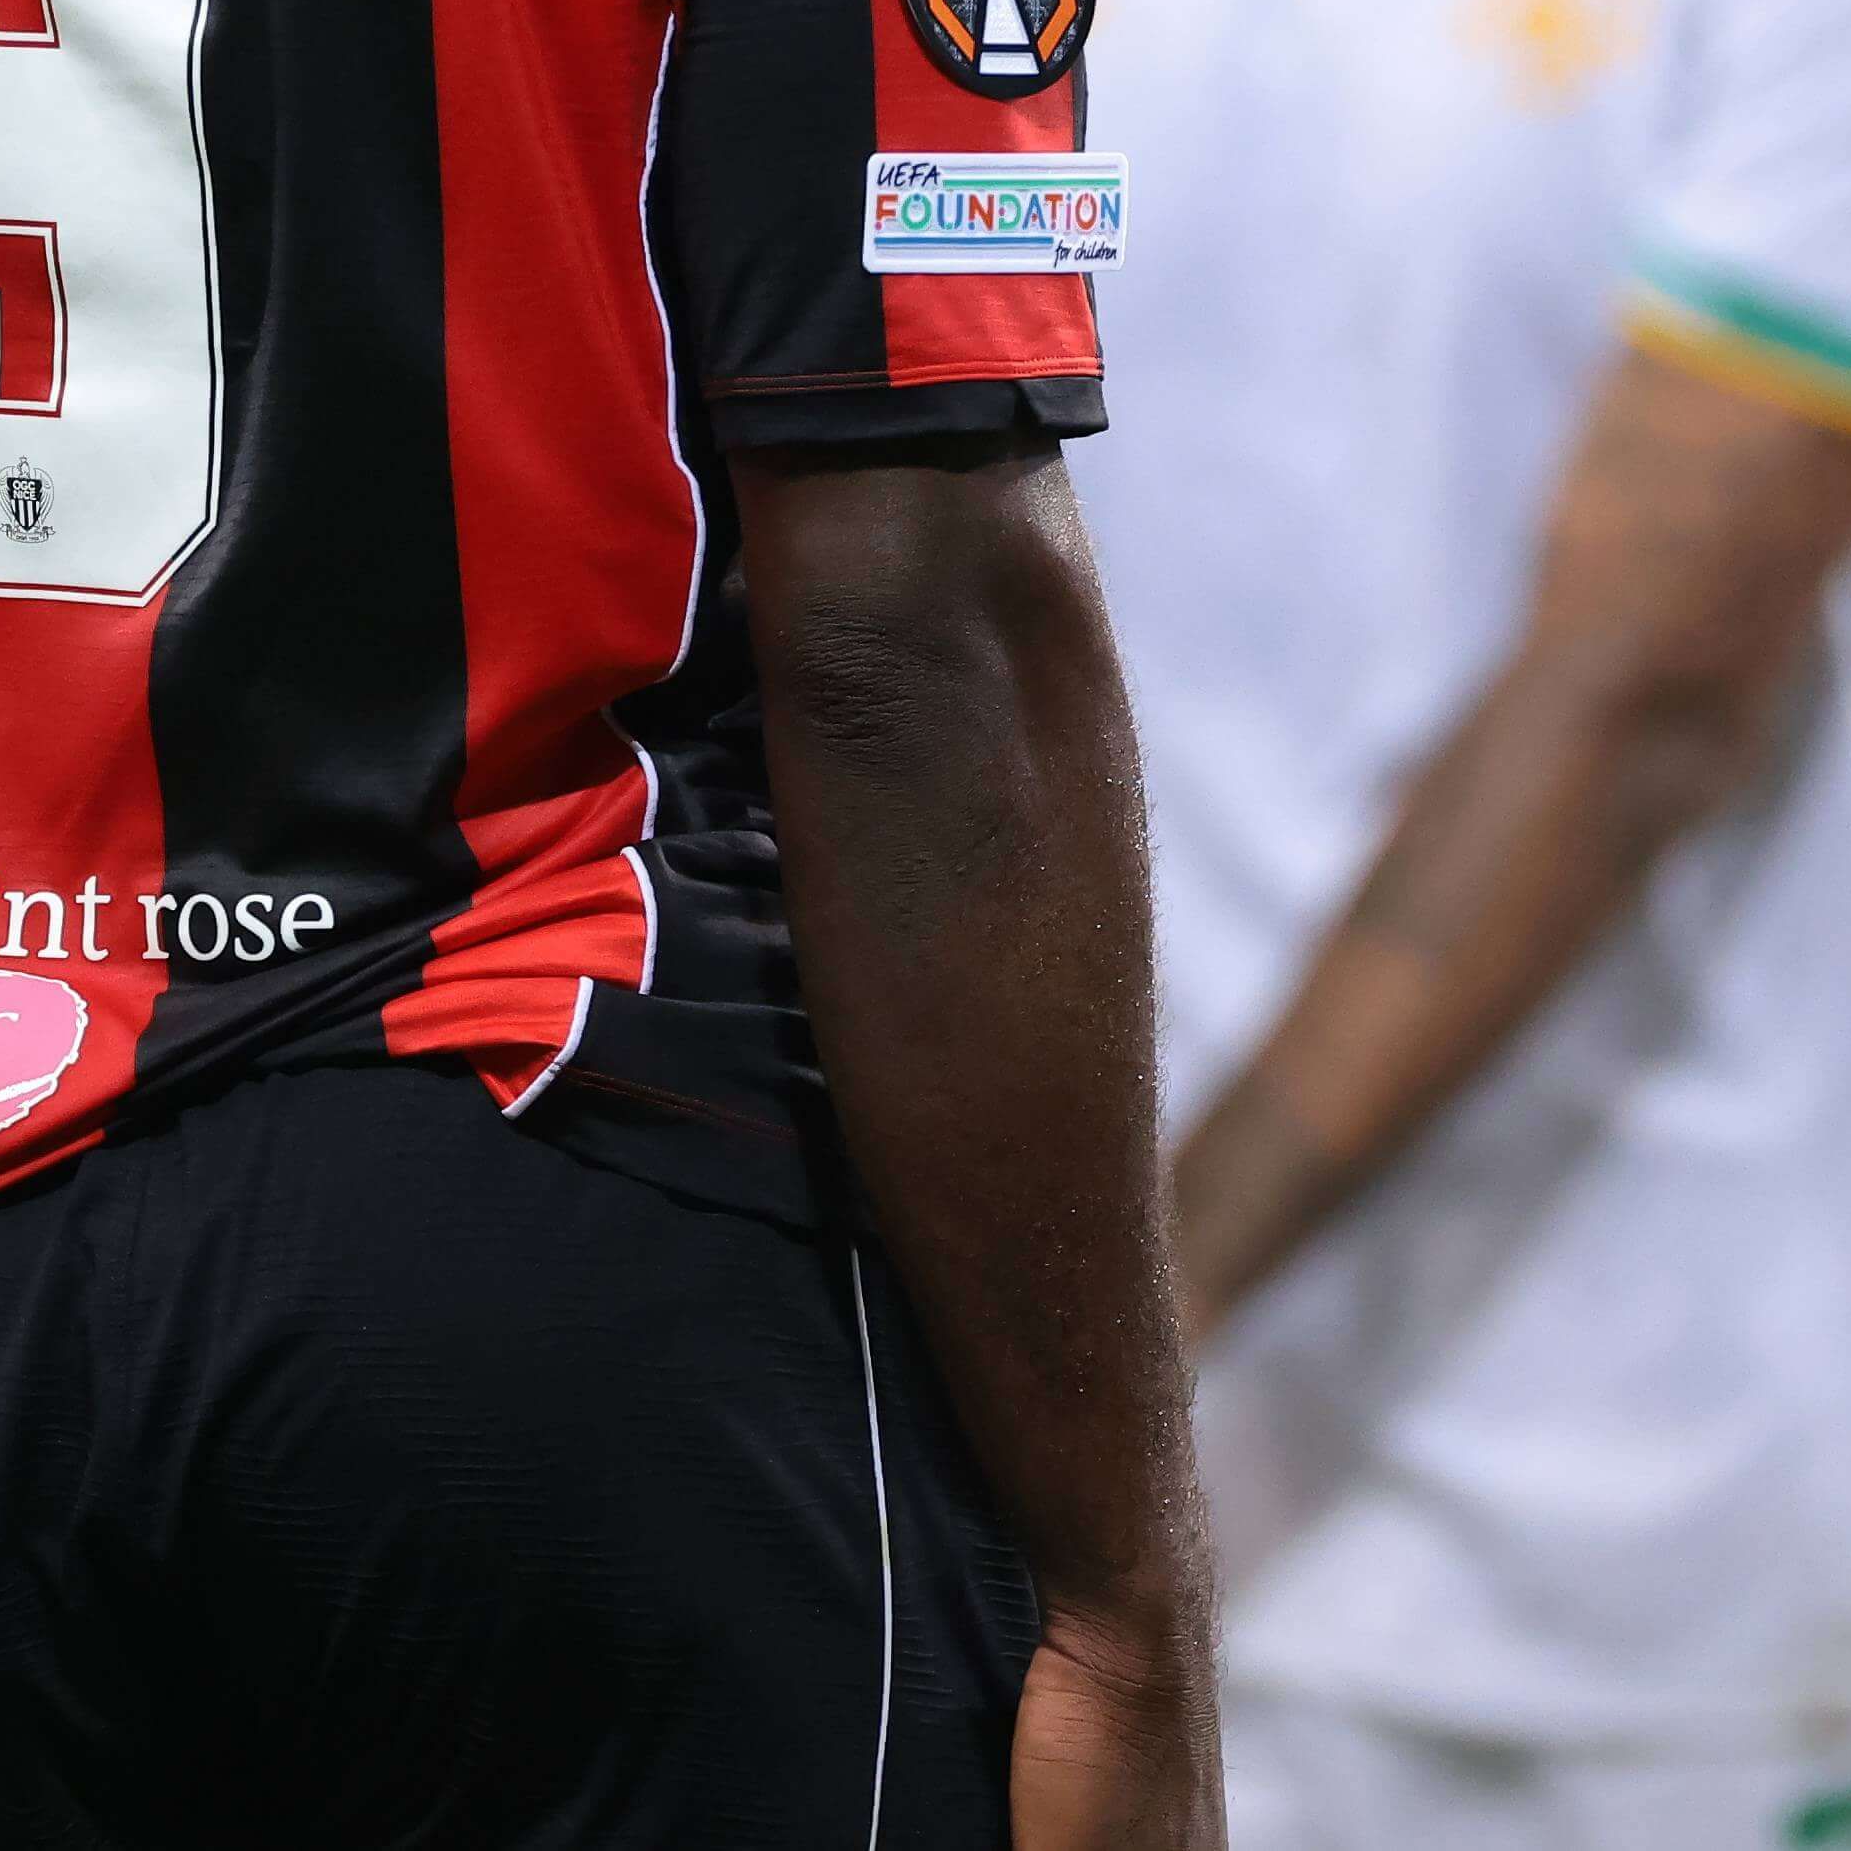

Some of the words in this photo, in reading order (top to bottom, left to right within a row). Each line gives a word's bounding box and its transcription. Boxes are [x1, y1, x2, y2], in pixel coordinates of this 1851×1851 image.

[877, 162, 941, 187] UEFA
[874, 193, 1120, 231] FOUNDATION
[1054, 240, 1071, 268] for
[1074, 240, 1117, 262] children
[12, 480, 36, 491] OGC
[13, 491, 37, 501] NICE
[141, 892, 335, 963] rose
